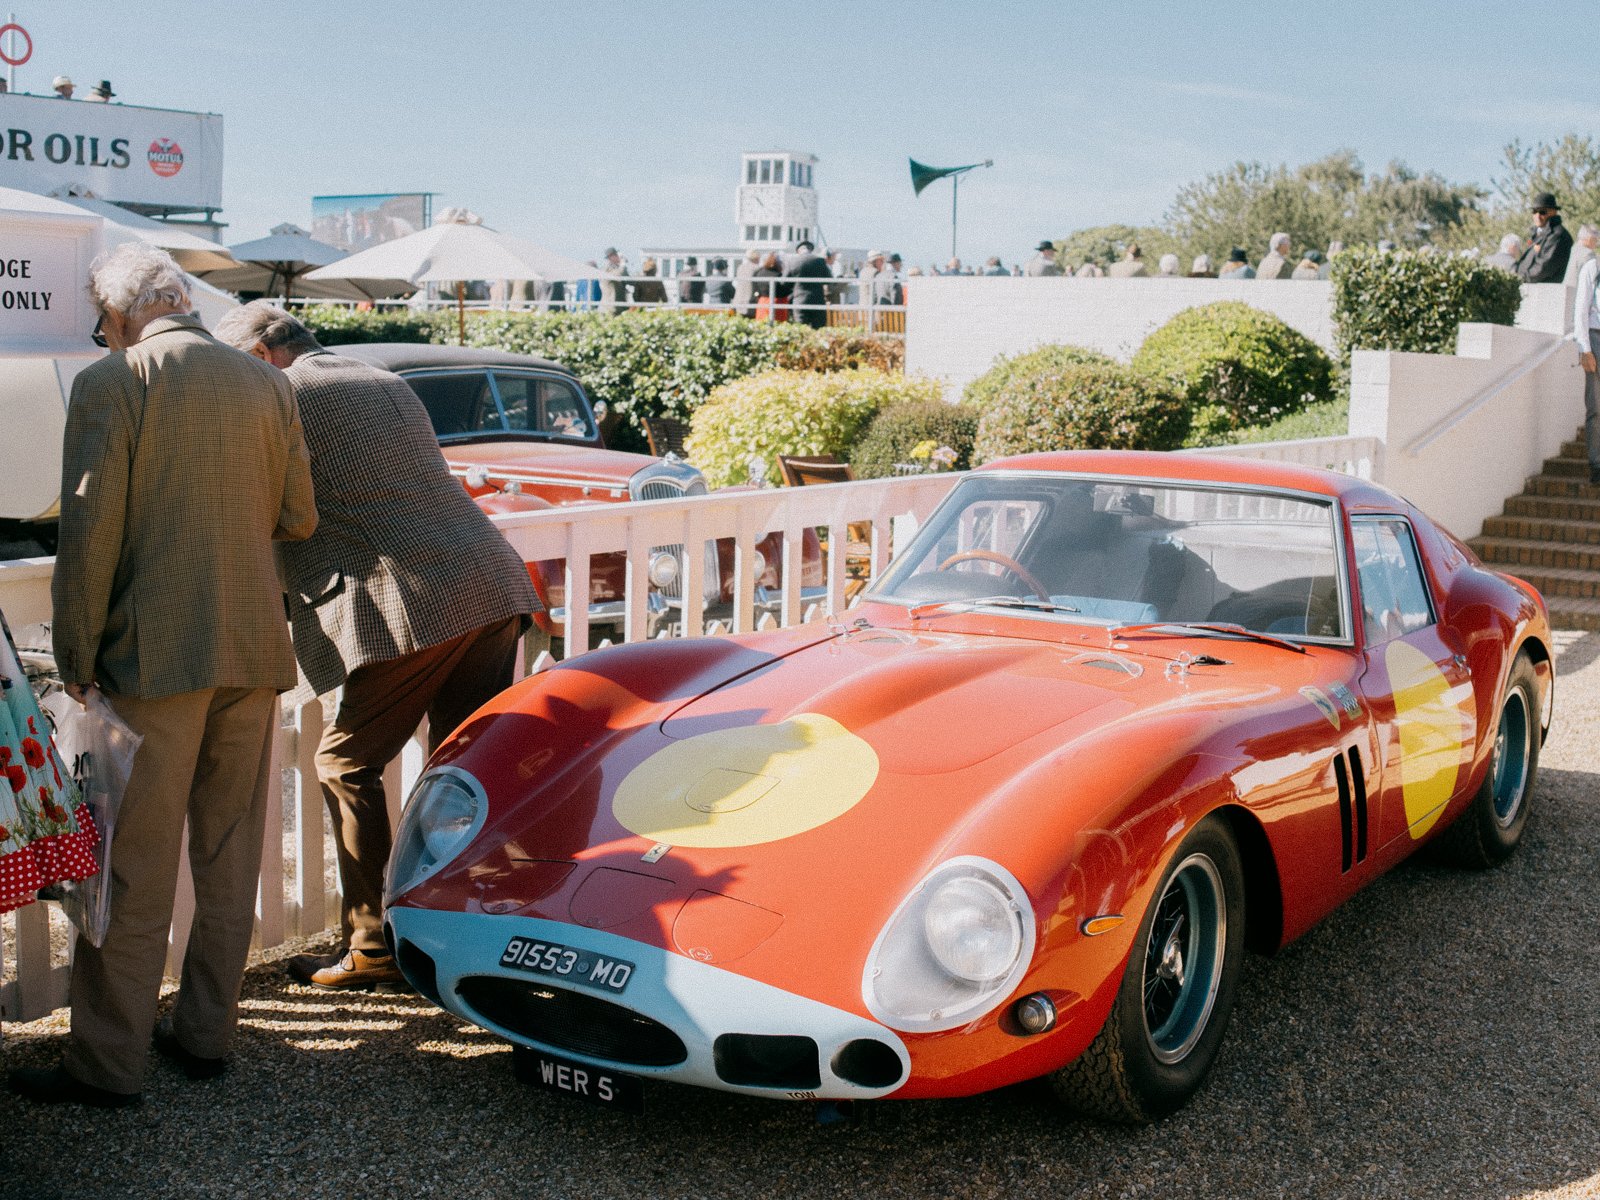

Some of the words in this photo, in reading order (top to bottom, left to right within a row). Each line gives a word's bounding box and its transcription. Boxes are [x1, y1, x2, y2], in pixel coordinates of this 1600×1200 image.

[0, 128, 35, 161] R
[44, 133, 131, 169] OILS
[149, 152, 182, 163] MOTUL
[2, 290, 52, 310] ONLY
[502, 940, 577, 975] 91553
[589, 958, 632, 988] MO
[540, 1059, 589, 1095] WER
[786, 1091, 817, 1099] TOW
